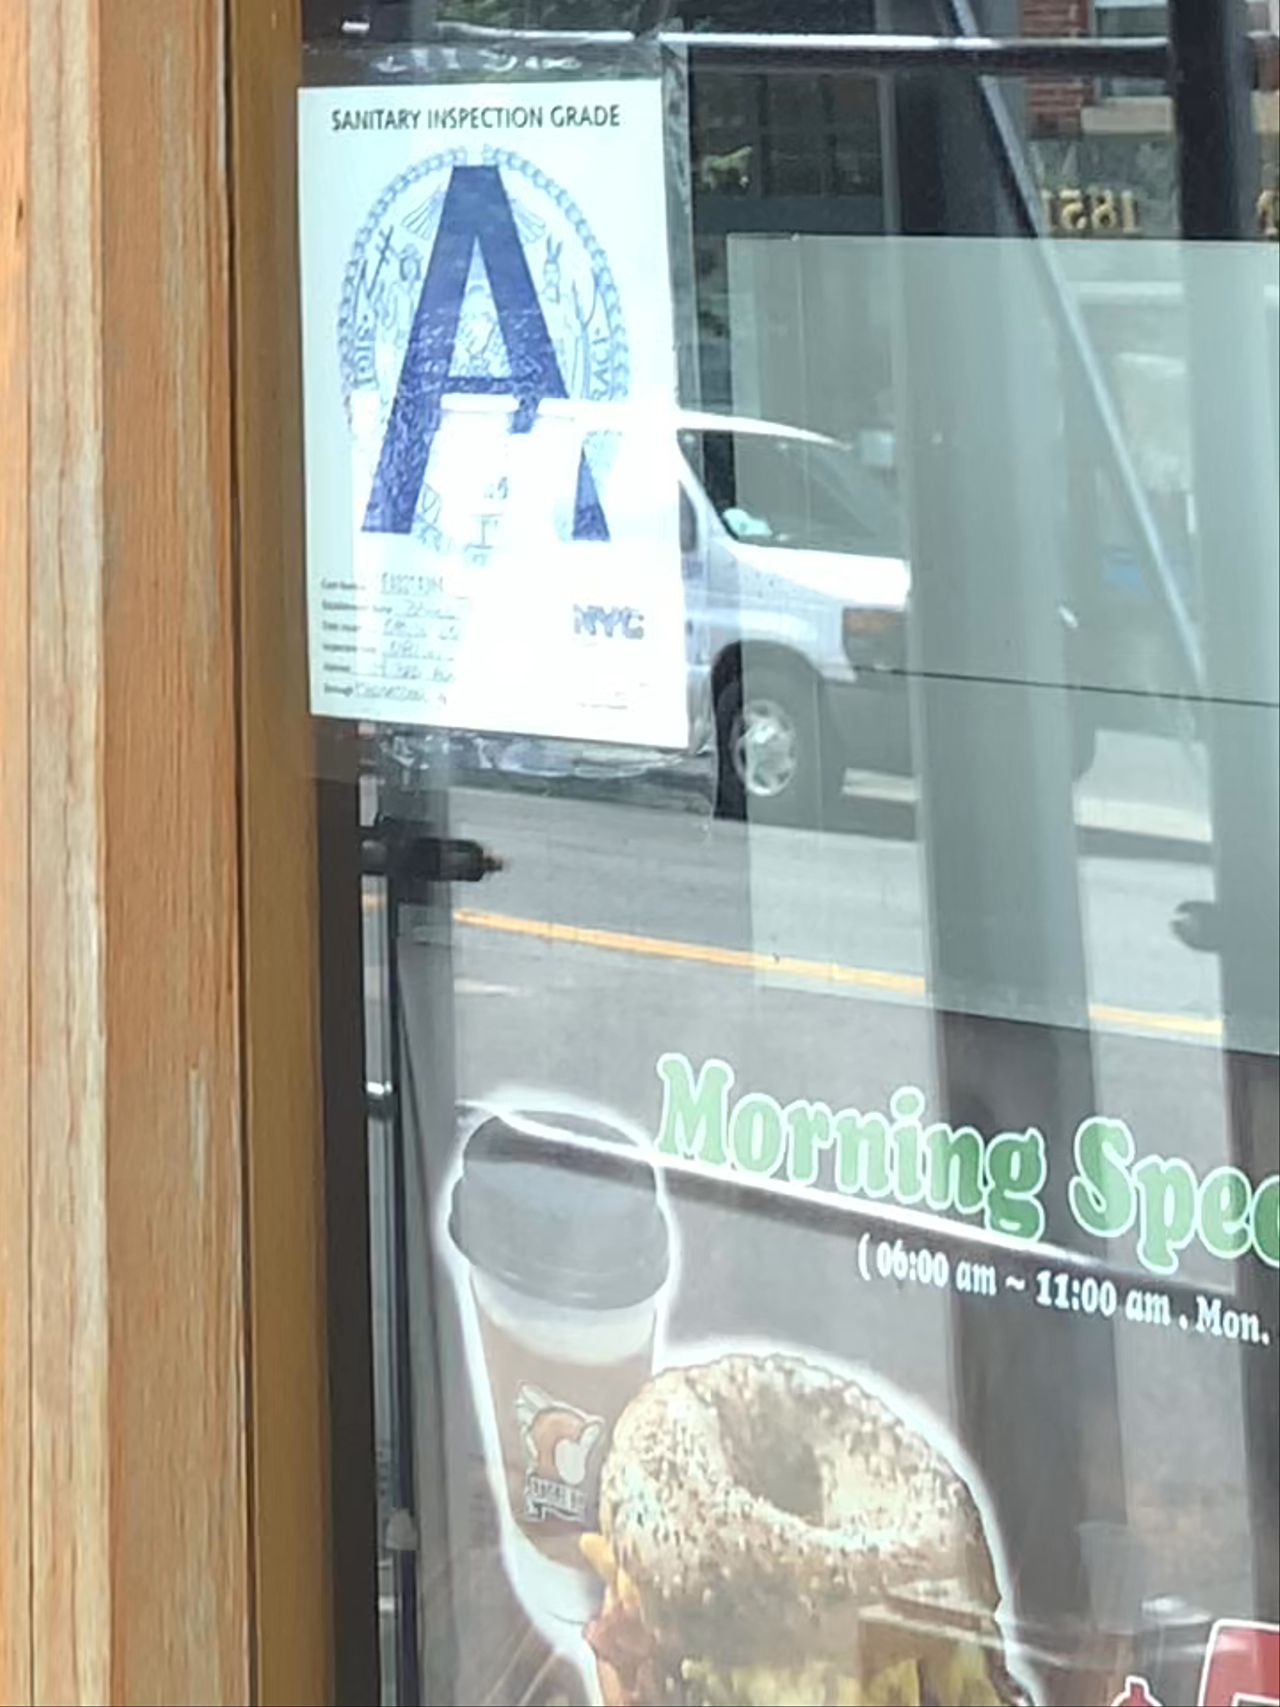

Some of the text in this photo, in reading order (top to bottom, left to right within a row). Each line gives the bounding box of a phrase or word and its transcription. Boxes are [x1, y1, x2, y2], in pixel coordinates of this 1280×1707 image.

[331, 104, 621, 130] SANITARY INSPECTION GRADE
[360, 164, 612, 542] A
[572, 603, 646, 641] NYC
[657, 1052, 1047, 1242] Morning
[955, 1262, 997, 1297] am
[1036, 1269, 1118, 1316] 11:00
[1195, 1295, 1270, 1346] Mon.
